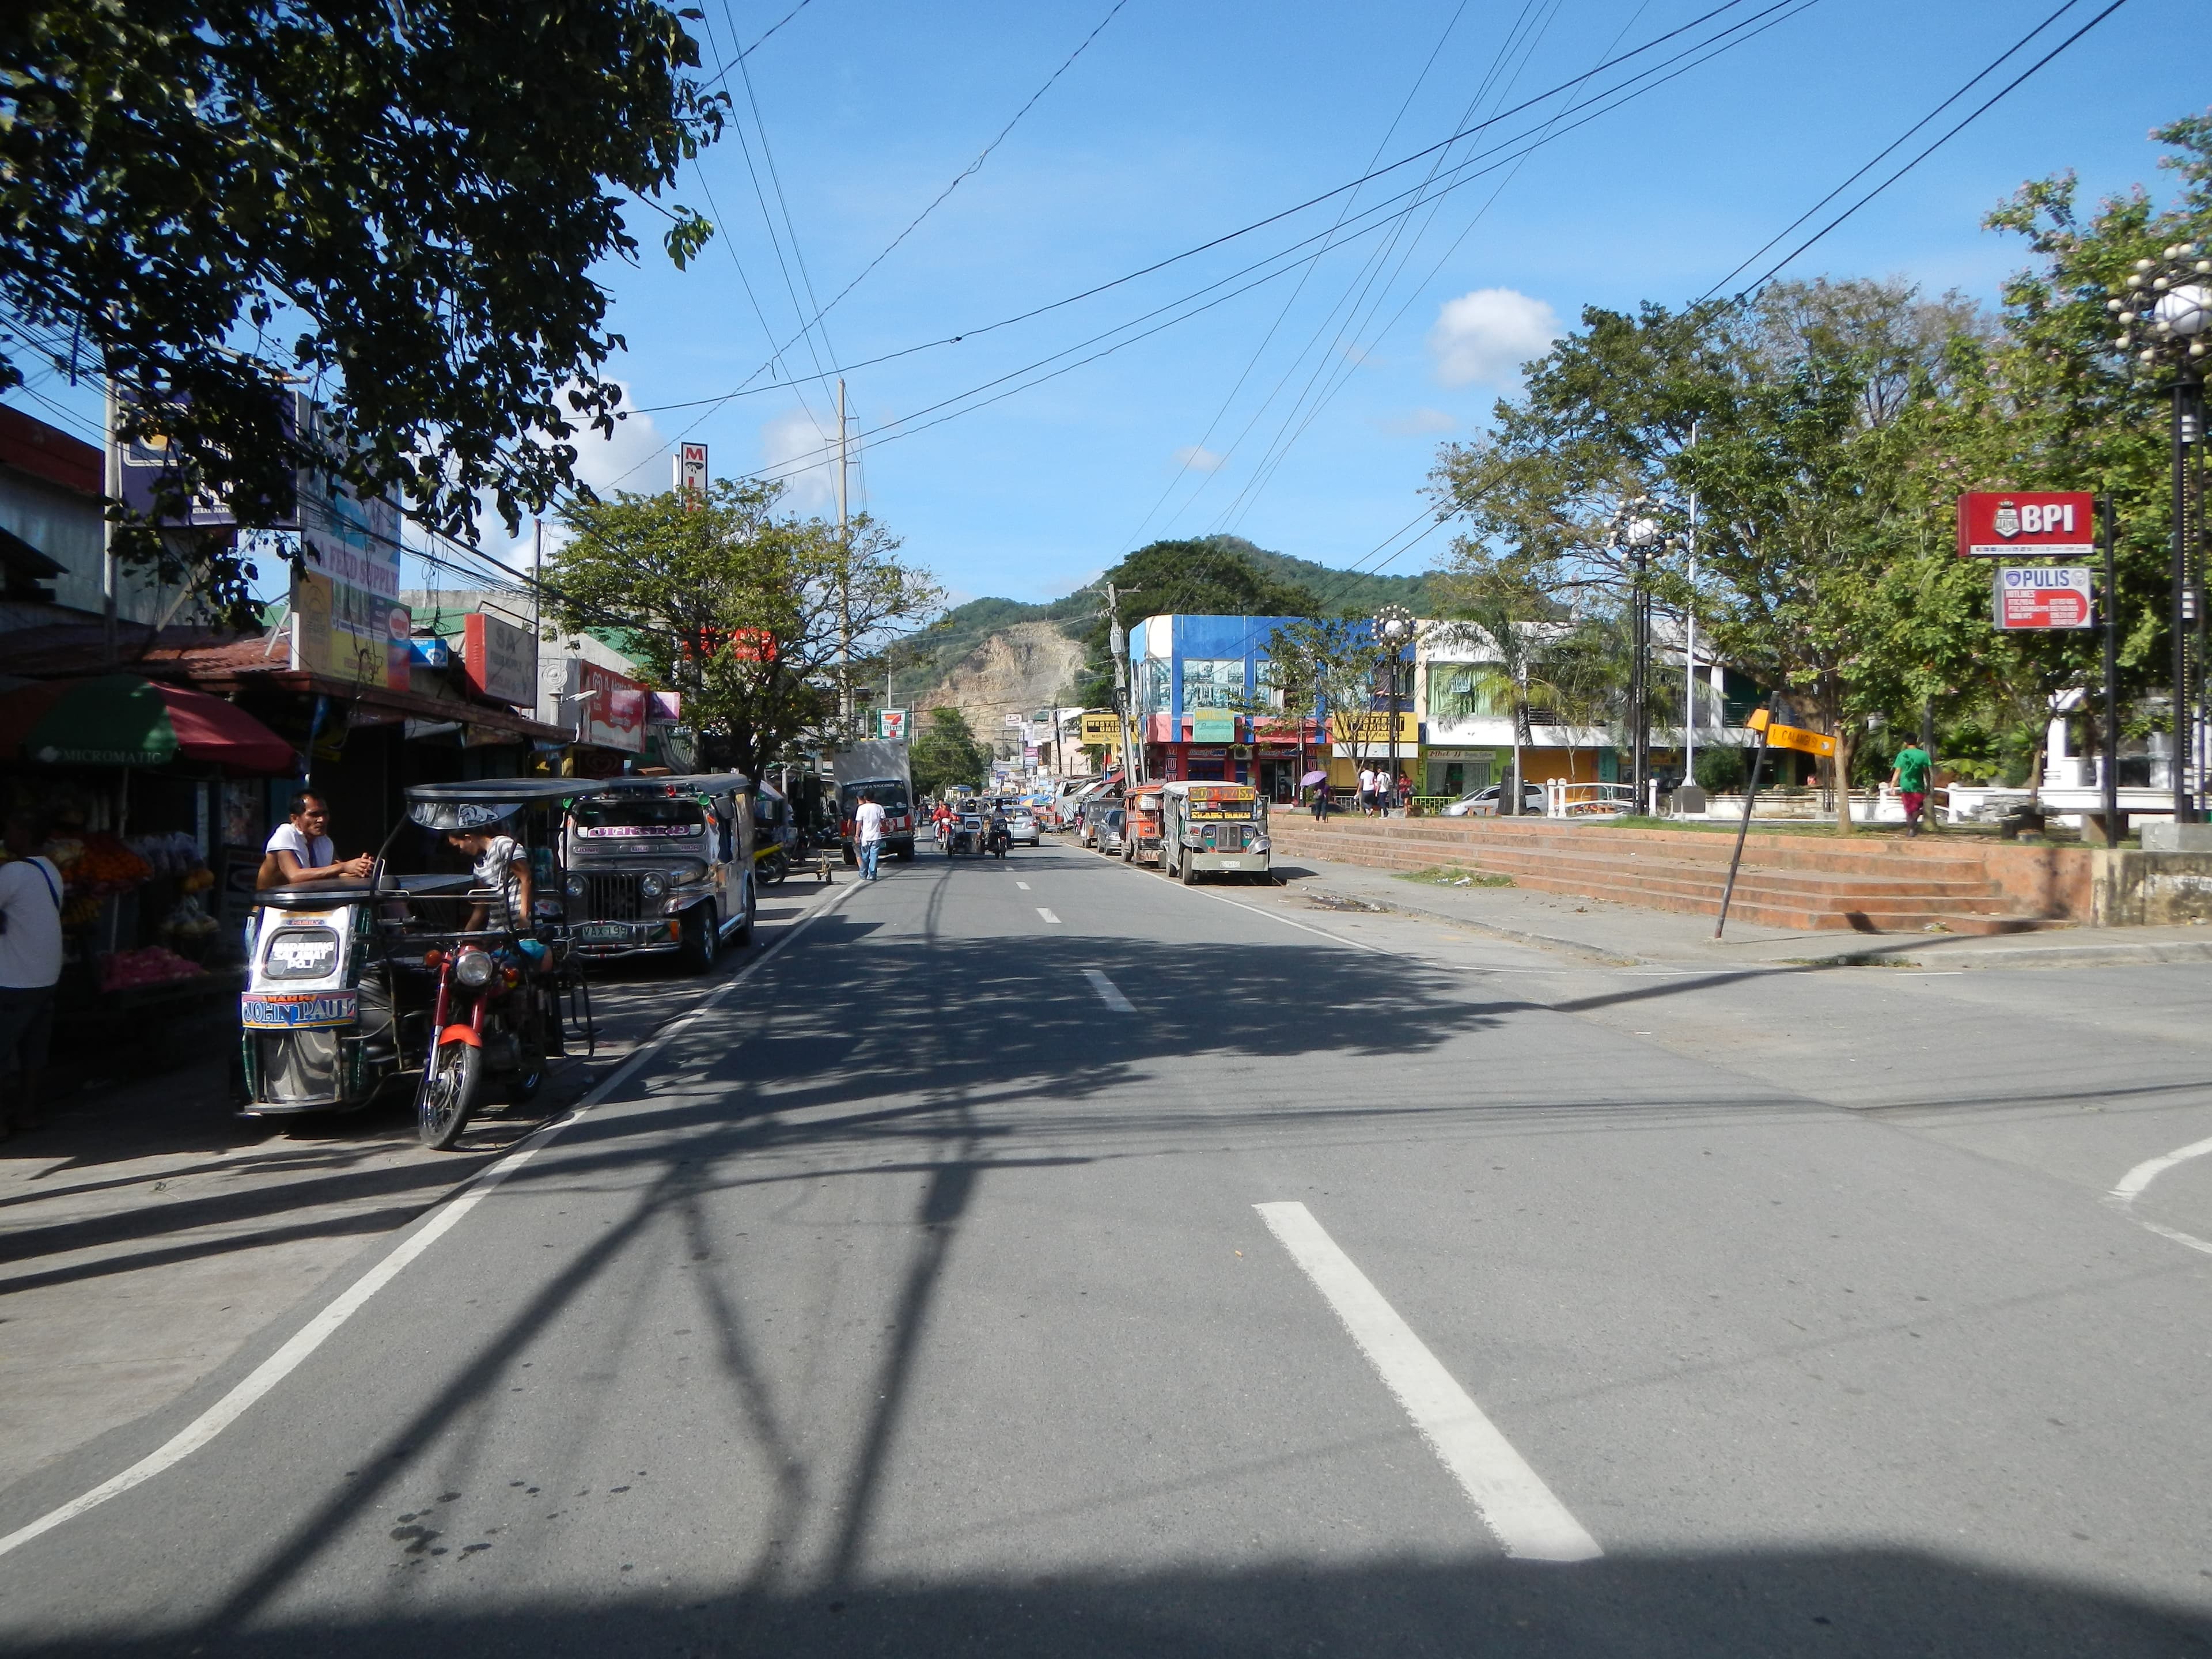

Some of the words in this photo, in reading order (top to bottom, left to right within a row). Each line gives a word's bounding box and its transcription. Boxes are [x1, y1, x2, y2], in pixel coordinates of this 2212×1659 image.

[2021, 504, 2073, 533] BPI
[2022, 570, 2070, 588] PULIS
[64, 749, 162, 764] MICROMATIC
[584, 926, 627, 937] VAX-199
[243, 1001, 294, 1024] JOHN
[296, 998, 356, 1021] PAUL
